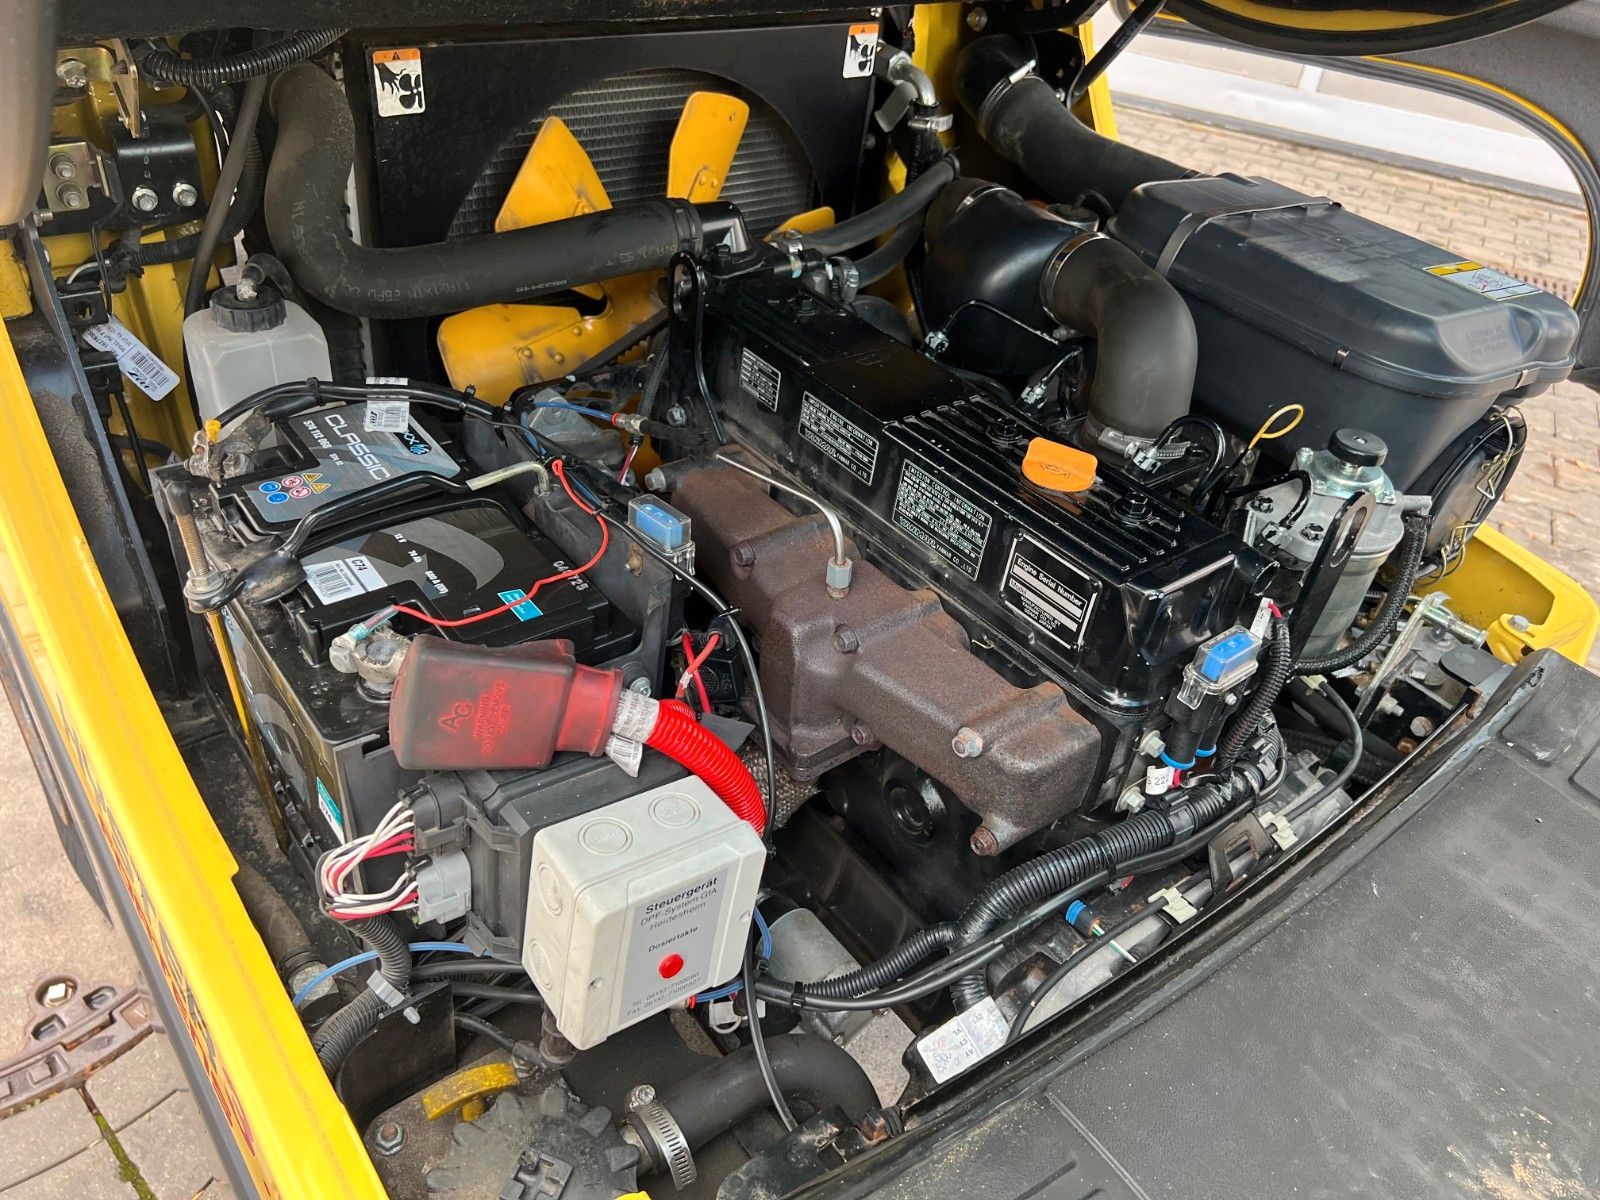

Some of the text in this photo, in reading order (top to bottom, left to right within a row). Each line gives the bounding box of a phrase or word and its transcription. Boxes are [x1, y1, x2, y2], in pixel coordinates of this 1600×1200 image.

[324, 413, 391, 481] CLASSIC
[907, 465, 986, 522] EMISSION CONTROL INFORMATION
[352, 559, 368, 571] C74
[1017, 557, 1083, 607] Engine Serial Number
[1023, 607, 1053, 631] OSAKA JAPAN
[475, 695, 490, 738] WARNING
[640, 896, 699, 926] DPF-System
[645, 877, 718, 915] Steuergerät
[650, 901, 706, 931] Heidesheim
[648, 926, 698, 952] Dosiertakte
